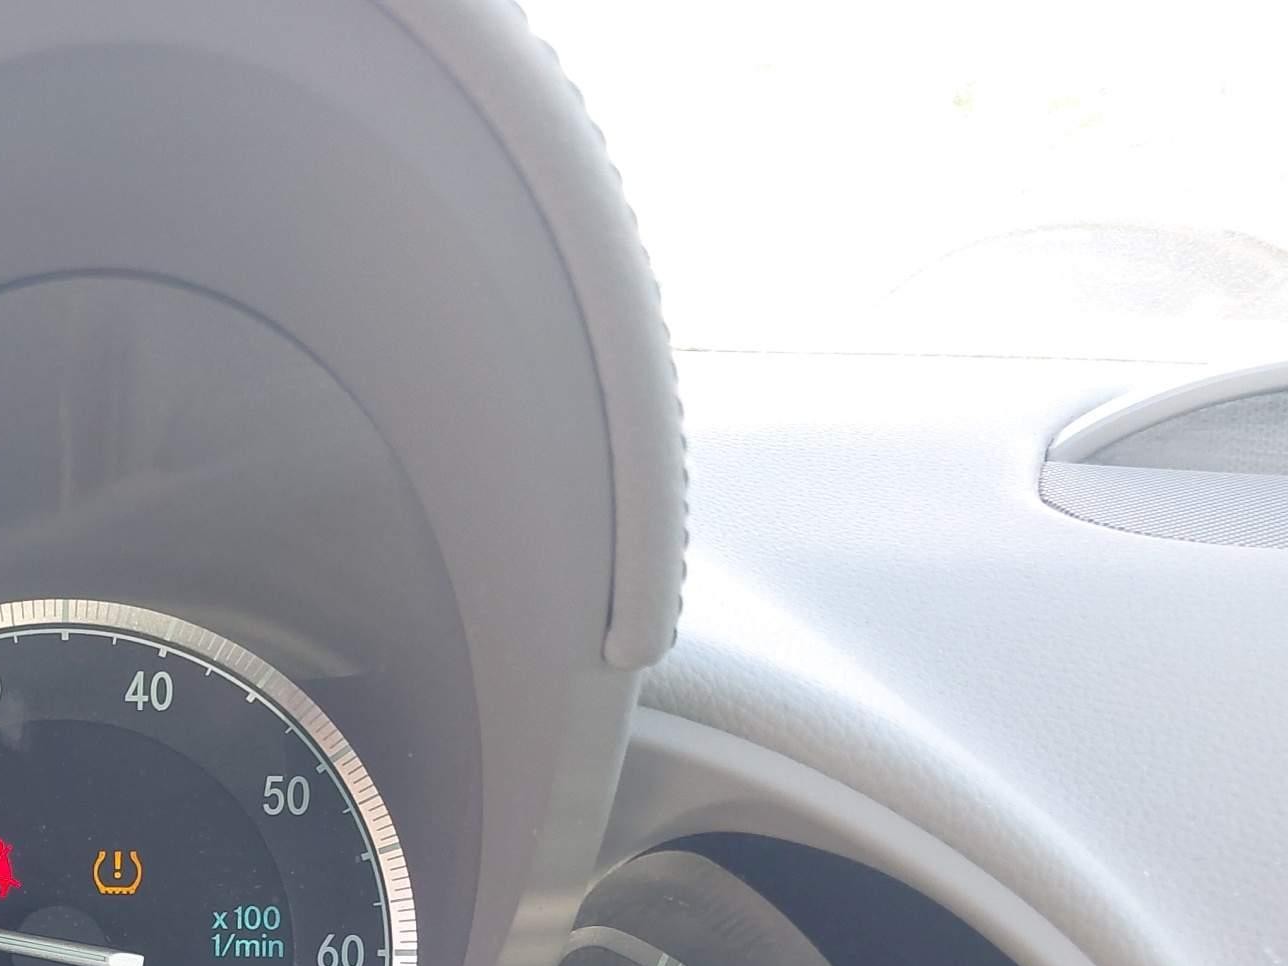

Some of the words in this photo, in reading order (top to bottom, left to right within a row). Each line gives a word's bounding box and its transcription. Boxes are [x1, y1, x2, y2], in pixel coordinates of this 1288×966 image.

[124, 670, 173, 712] 40
[263, 775, 310, 816] 50
[211, 933, 284, 958] 1/min
